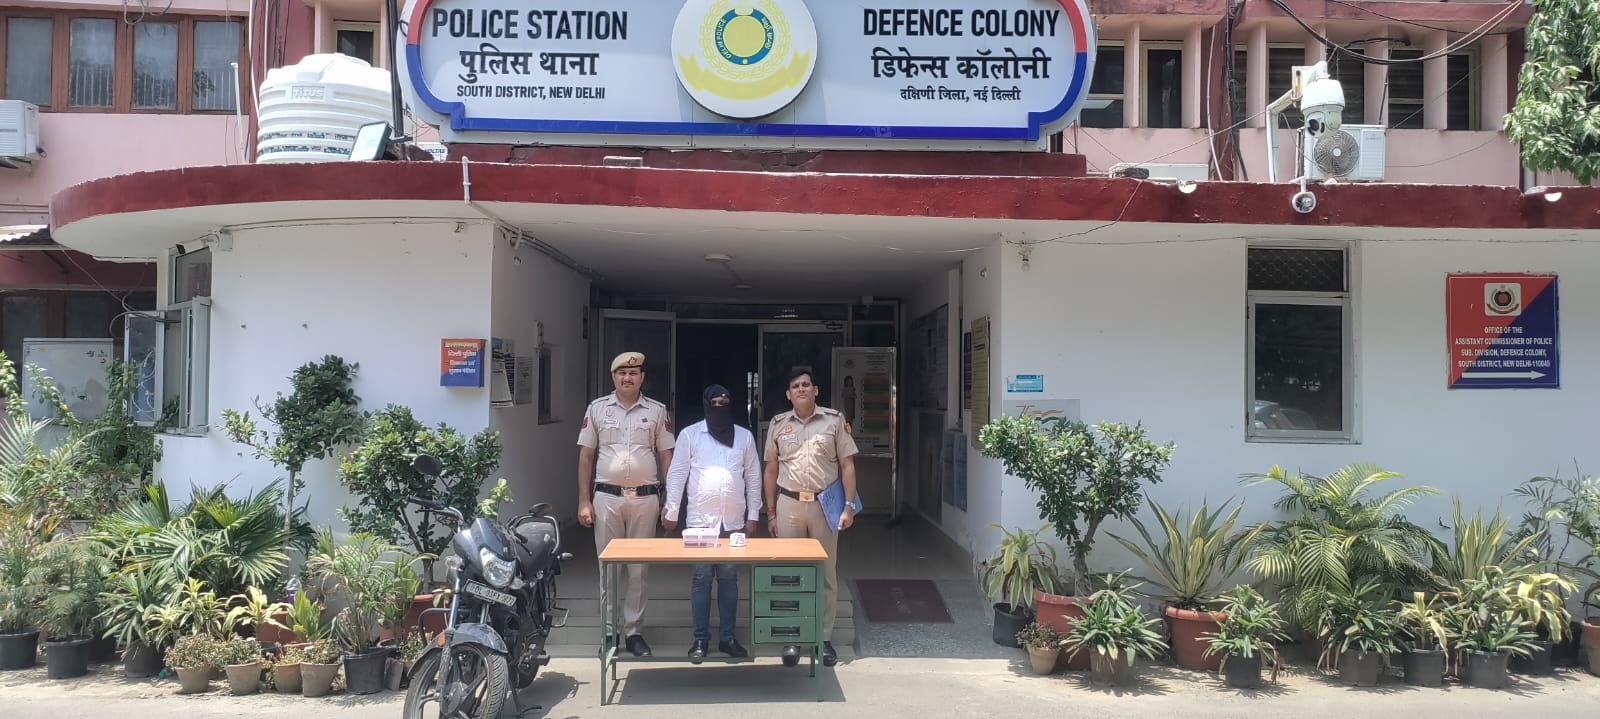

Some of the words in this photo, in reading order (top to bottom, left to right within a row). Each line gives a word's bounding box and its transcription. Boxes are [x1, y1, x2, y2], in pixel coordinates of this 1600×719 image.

[432, 8, 519, 39] POLICE
[527, 10, 628, 40] STATION
[716, 18, 727, 40] POLICE
[864, 9, 963, 36] DEFENCE
[971, 9, 1060, 37] COLONY
[458, 43, 533, 84] पुलिस
[539, 52, 600, 76] थाना
[871, 47, 950, 78] डिफेन्स
[956, 47, 1052, 79] कॉलोनी
[457, 85, 492, 98] SOUTH
[496, 86, 546, 100] DISTRICT,
[549, 87, 573, 99] NEW
[576, 87, 606, 99] DELHI
[900, 86, 936, 100] दक्षिणी
[938, 86, 970, 102] जिला,
[973, 86, 989, 101] नई
[991, 86, 1022, 101] दिल्ली
[1524, 349, 1547, 357] COLONY,
